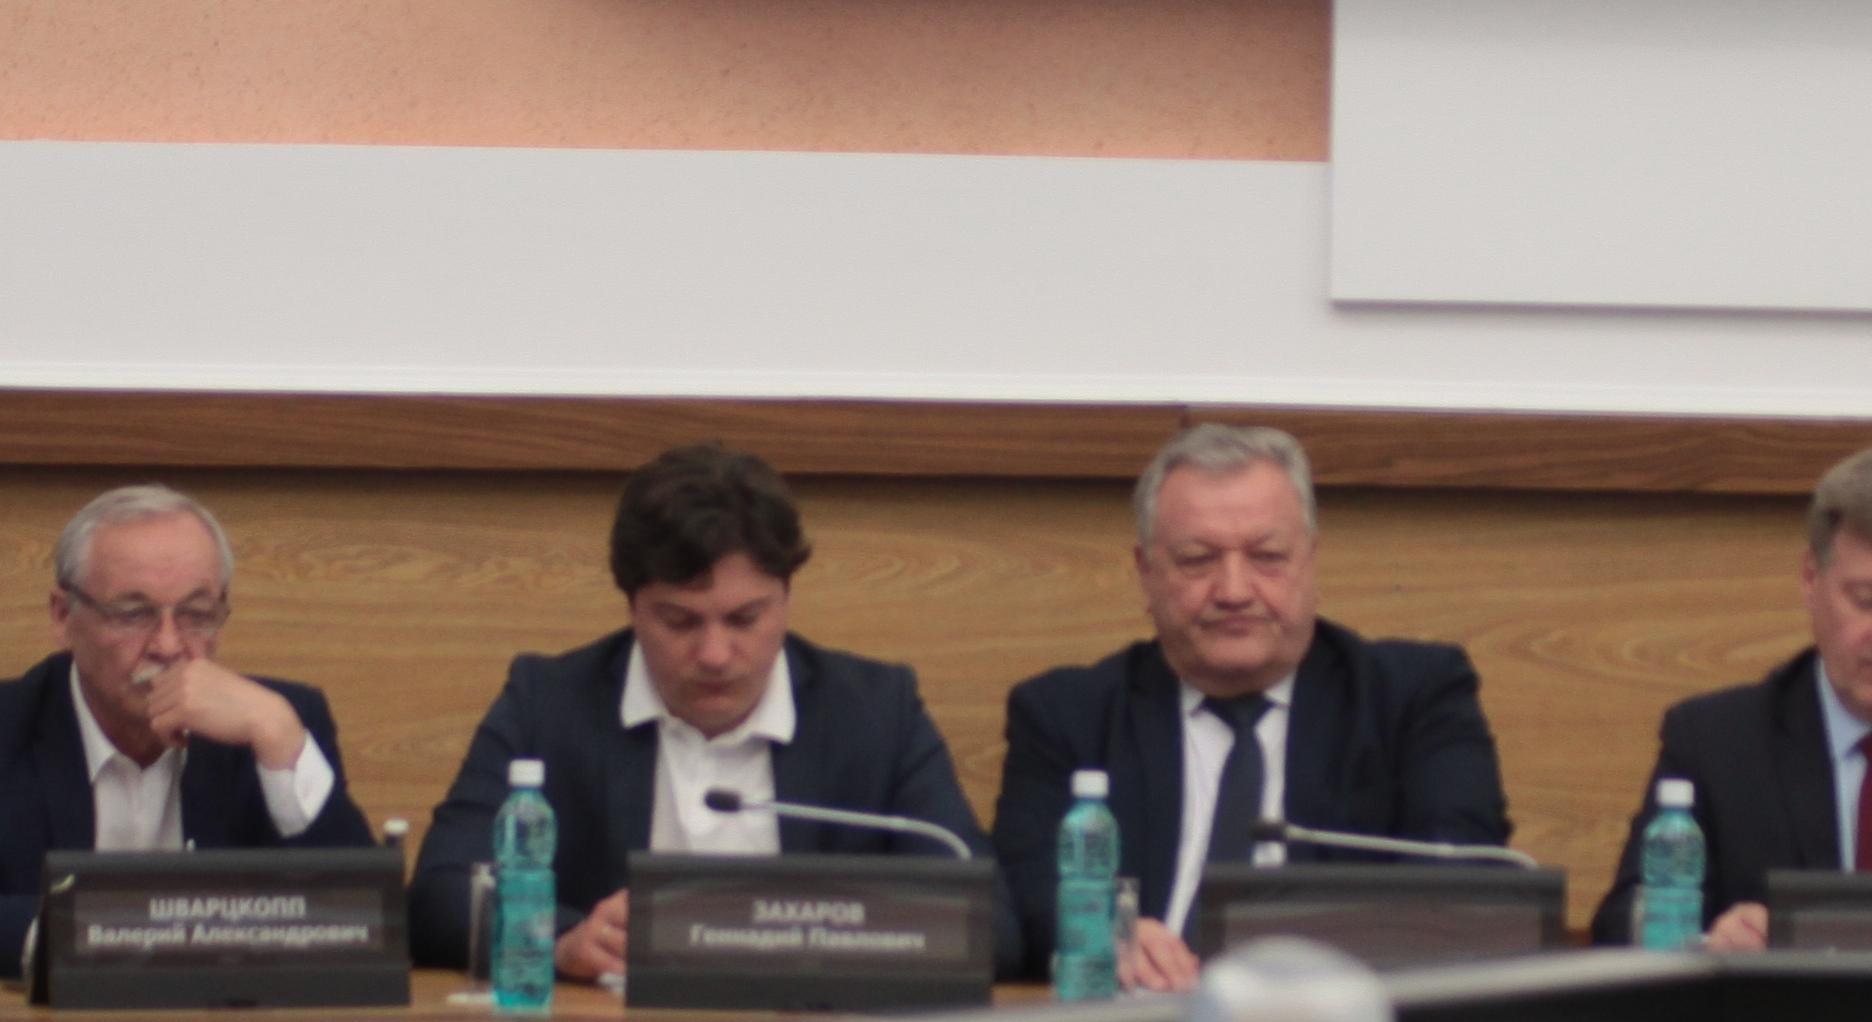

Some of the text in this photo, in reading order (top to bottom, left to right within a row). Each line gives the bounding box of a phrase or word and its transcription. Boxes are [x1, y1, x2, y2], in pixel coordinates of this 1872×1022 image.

[149, 895, 306, 923] ШВАРЦКОПП
[753, 899, 865, 924] ЗАХАРОВ
[87, 923, 369, 949] Валерий Александрович
[689, 923, 804, 947] Геннадий
